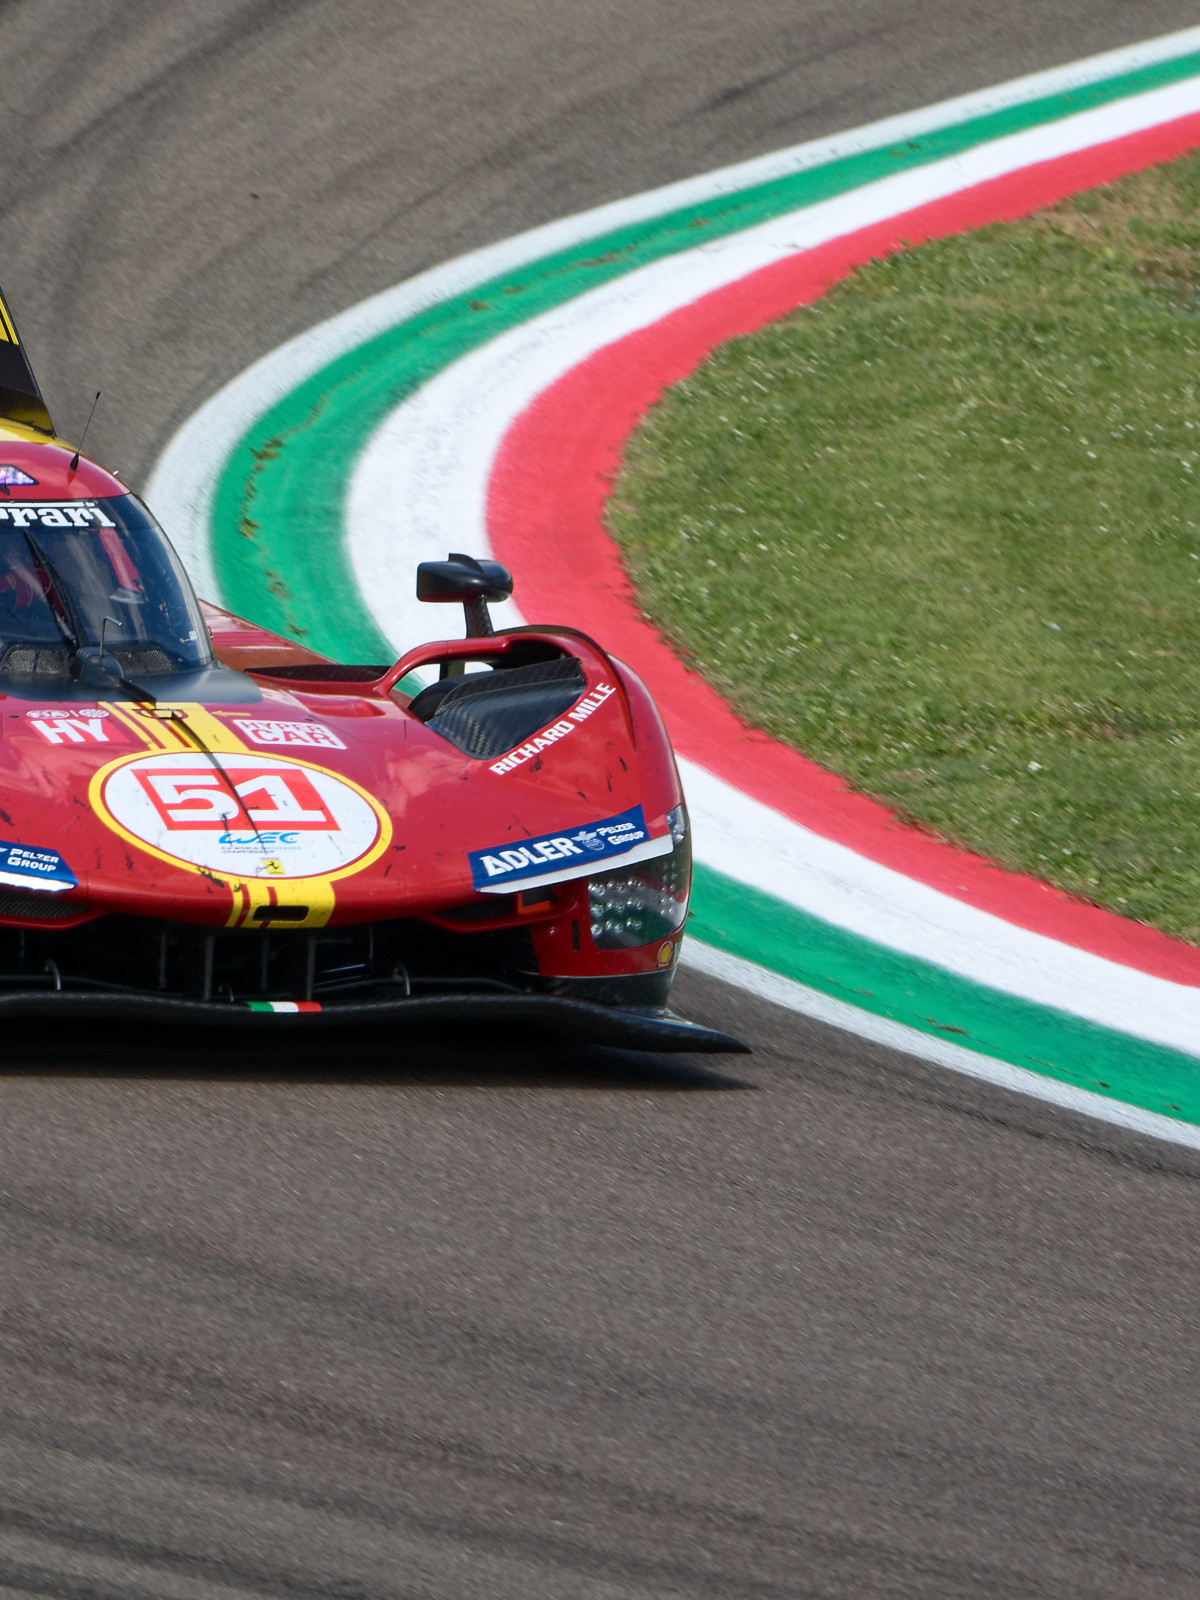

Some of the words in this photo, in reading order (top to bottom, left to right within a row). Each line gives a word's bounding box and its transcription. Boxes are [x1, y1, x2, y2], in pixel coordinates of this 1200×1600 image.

[31, 718, 110, 744] HY
[240, 720, 326, 734] HYPER
[489, 720, 575, 775] RICHARD
[568, 682, 616, 722] MILLE
[251, 729, 338, 747] CAR
[147, 774, 328, 822] 51
[596, 822, 636, 836] PELZER
[218, 831, 300, 844] WEC
[607, 830, 645, 845] GROUP
[7, 856, 57, 872] GROUP
[10, 848, 59, 864] PELZER
[480, 837, 584, 877] ADLER
